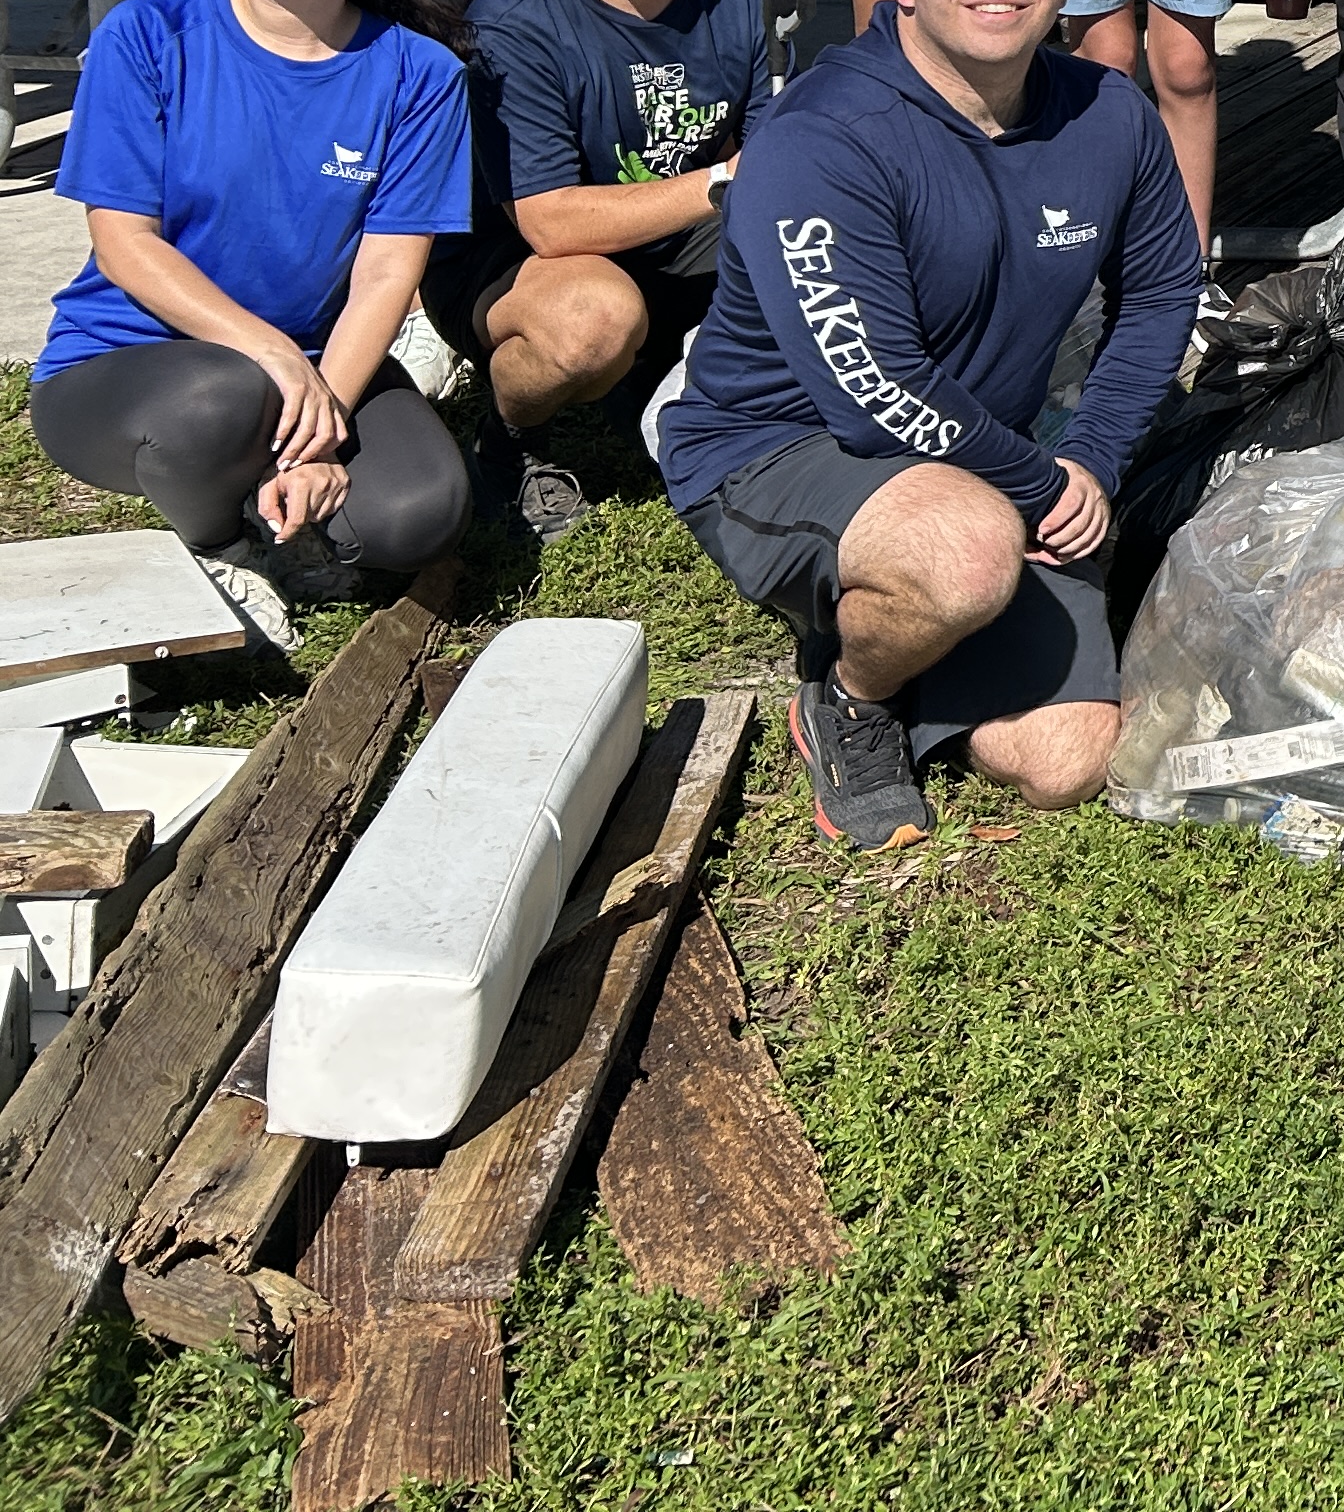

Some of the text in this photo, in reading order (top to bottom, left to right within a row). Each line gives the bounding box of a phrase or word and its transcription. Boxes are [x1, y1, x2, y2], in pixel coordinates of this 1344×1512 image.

[635, 85, 690, 111] RACE
[678, 100, 729, 128] OUR
[775, 216, 963, 457] SEAKEEPERS
